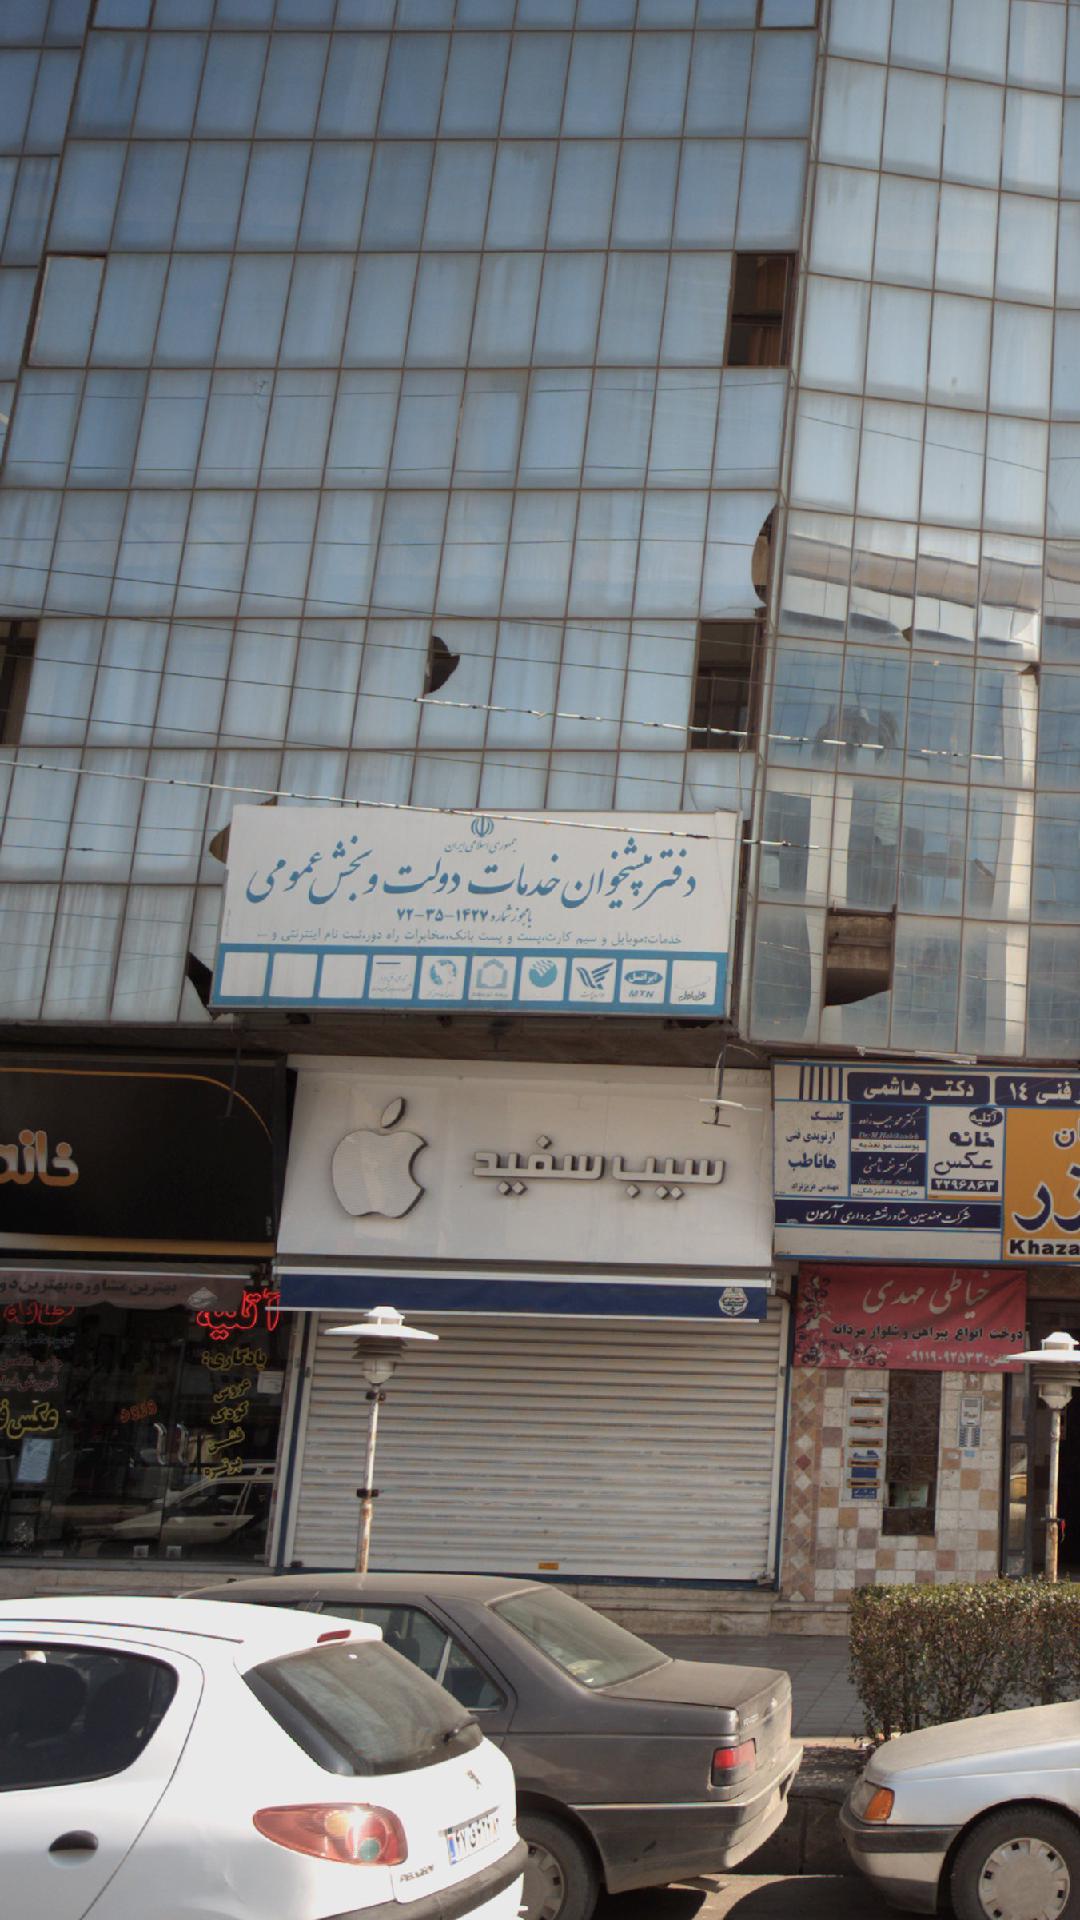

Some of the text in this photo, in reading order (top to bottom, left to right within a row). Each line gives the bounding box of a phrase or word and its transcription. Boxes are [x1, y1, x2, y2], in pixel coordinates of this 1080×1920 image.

[246, 835, 696, 911] دفتر پیشخوان خدمات دولت و بخش عمومی
[863, 1076, 974, 1101] دکتر هاشمی
[1036, 1080, 1073, 1105] فنی
[810, 1111, 844, 1124] کلینیک
[970, 1111, 997, 1125] آتلیه
[949, 1131, 995, 1147] خانه
[472, 1134, 726, 1199] سیب سفید
[934, 1151, 993, 1175] عکس
[841, 1211, 870, 1224] برداری
[887, 1209, 909, 1221] مشاور
[909, 1211, 942, 1224] مهندسین
[941, 1207, 971, 1224] شرکت
[129, 1281, 177, 1297] بهترین
[862, 1270, 991, 1319] خیاطی مهدی
[832, 1324, 866, 1339] مردانه
[870, 1325, 899, 1340] شلوار
[955, 1327, 983, 1341] انواع
[989, 1330, 1024, 1343] دوخت
[211, 1400, 249, 1424] کودک
[6, 1402, 59, 1439] عکس
